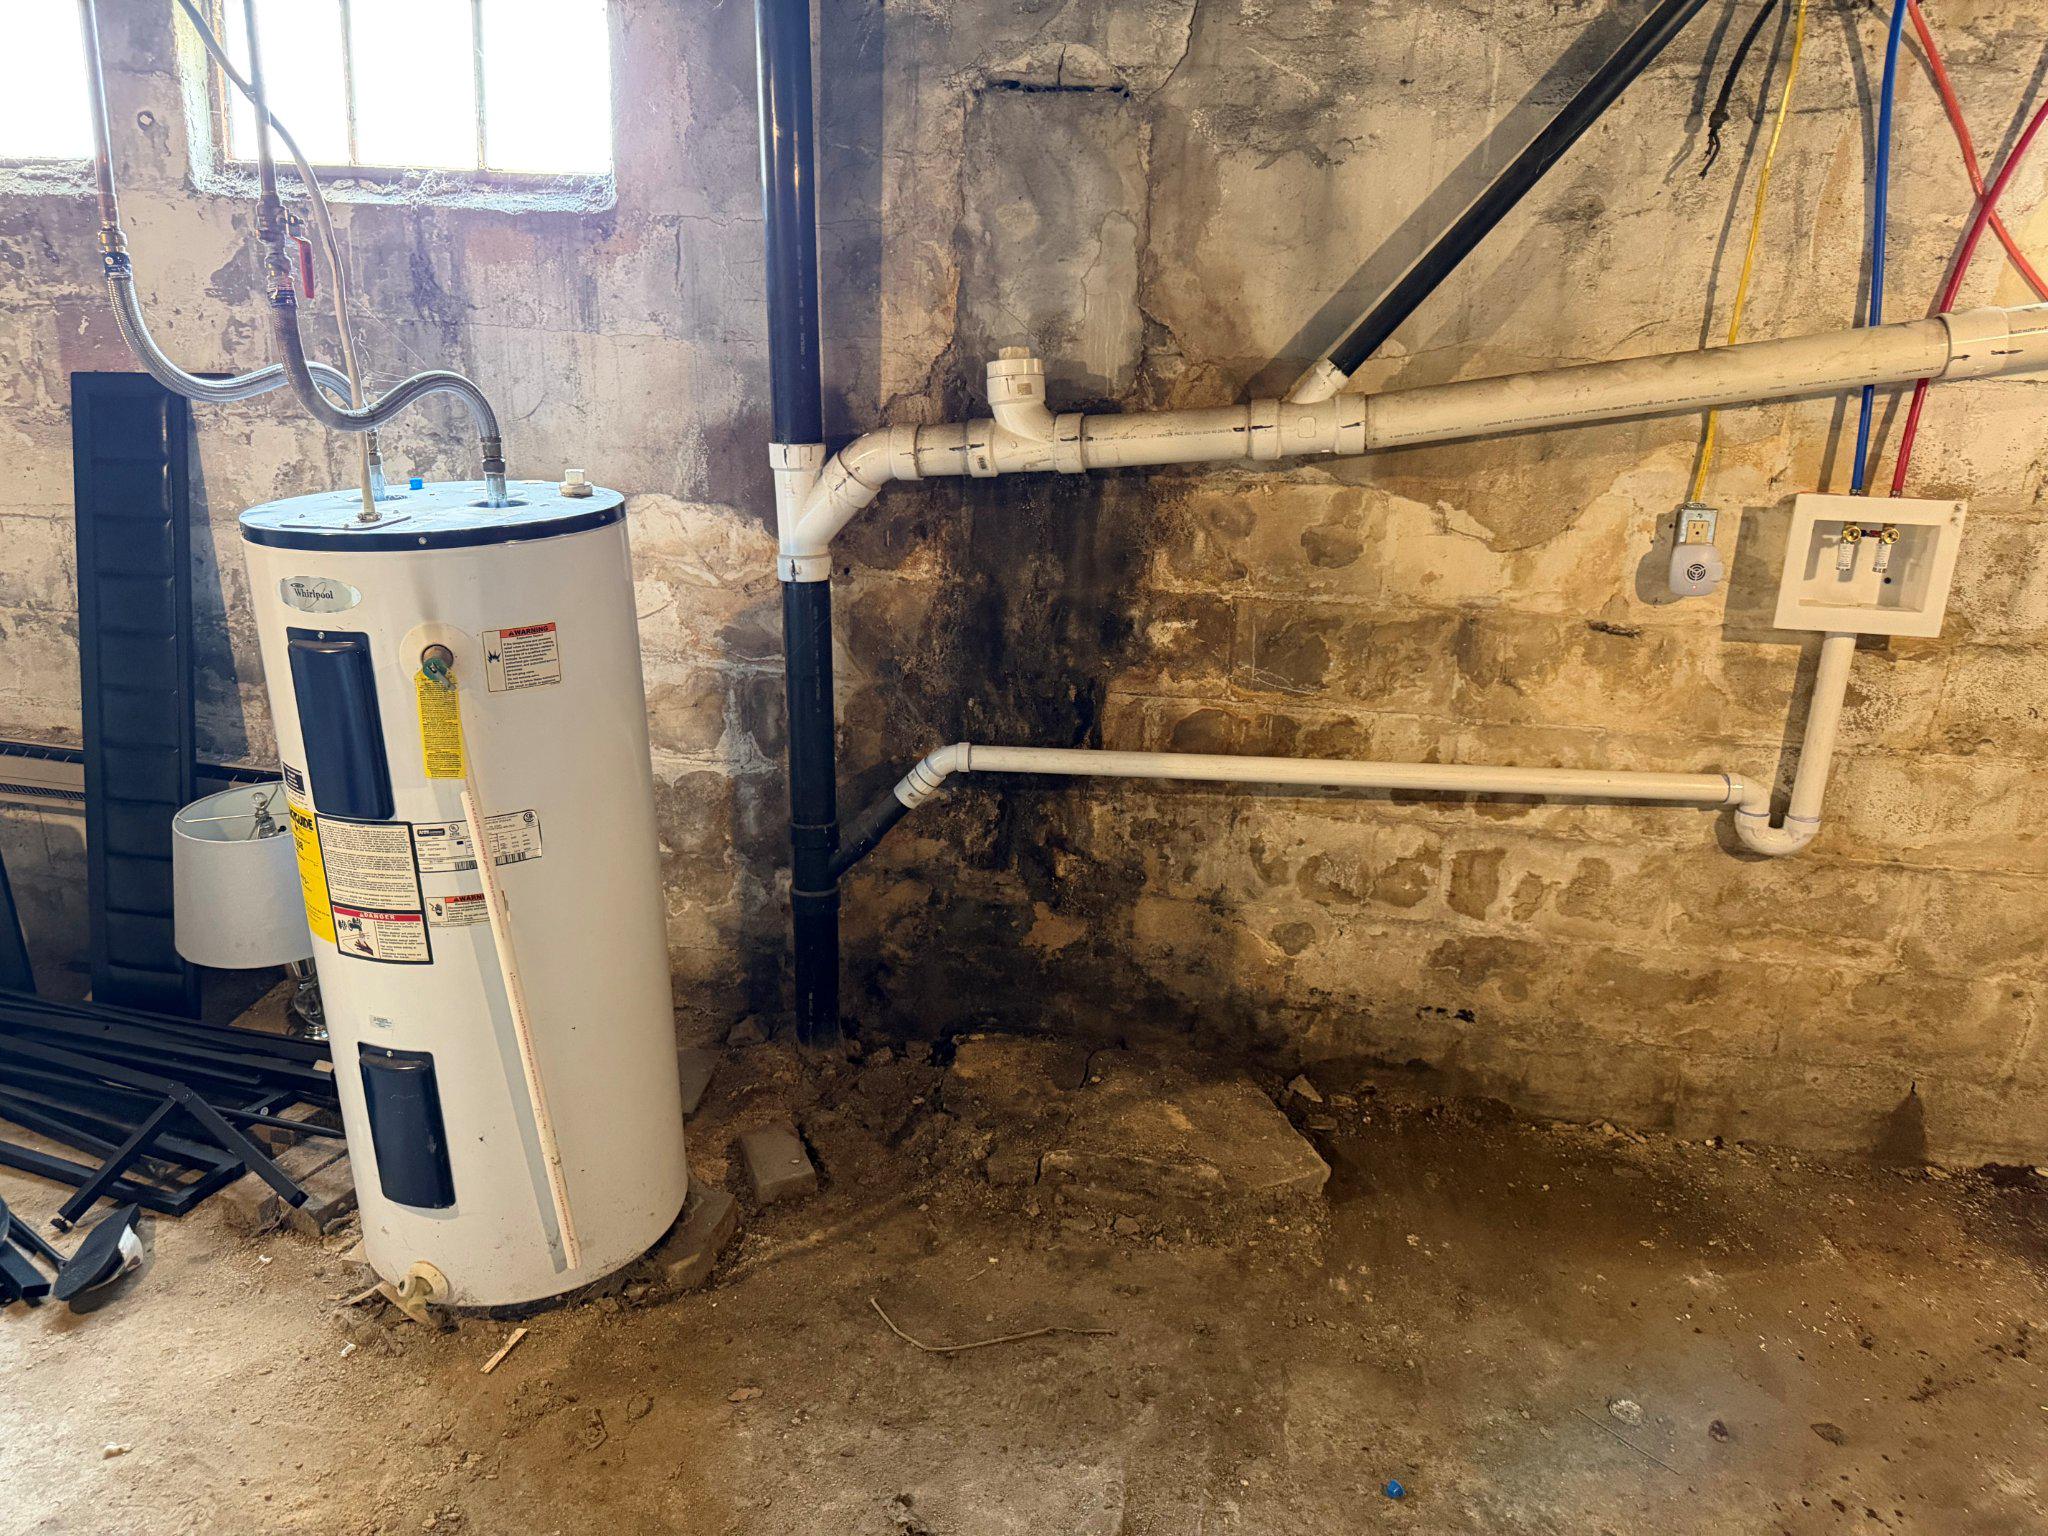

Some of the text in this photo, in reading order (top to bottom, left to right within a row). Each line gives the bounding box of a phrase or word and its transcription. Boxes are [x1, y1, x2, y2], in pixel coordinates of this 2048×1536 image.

[294, 588, 334, 600] Whirlpool
[515, 626, 549, 636] WARNING
[365, 911, 396, 920] DANGER
